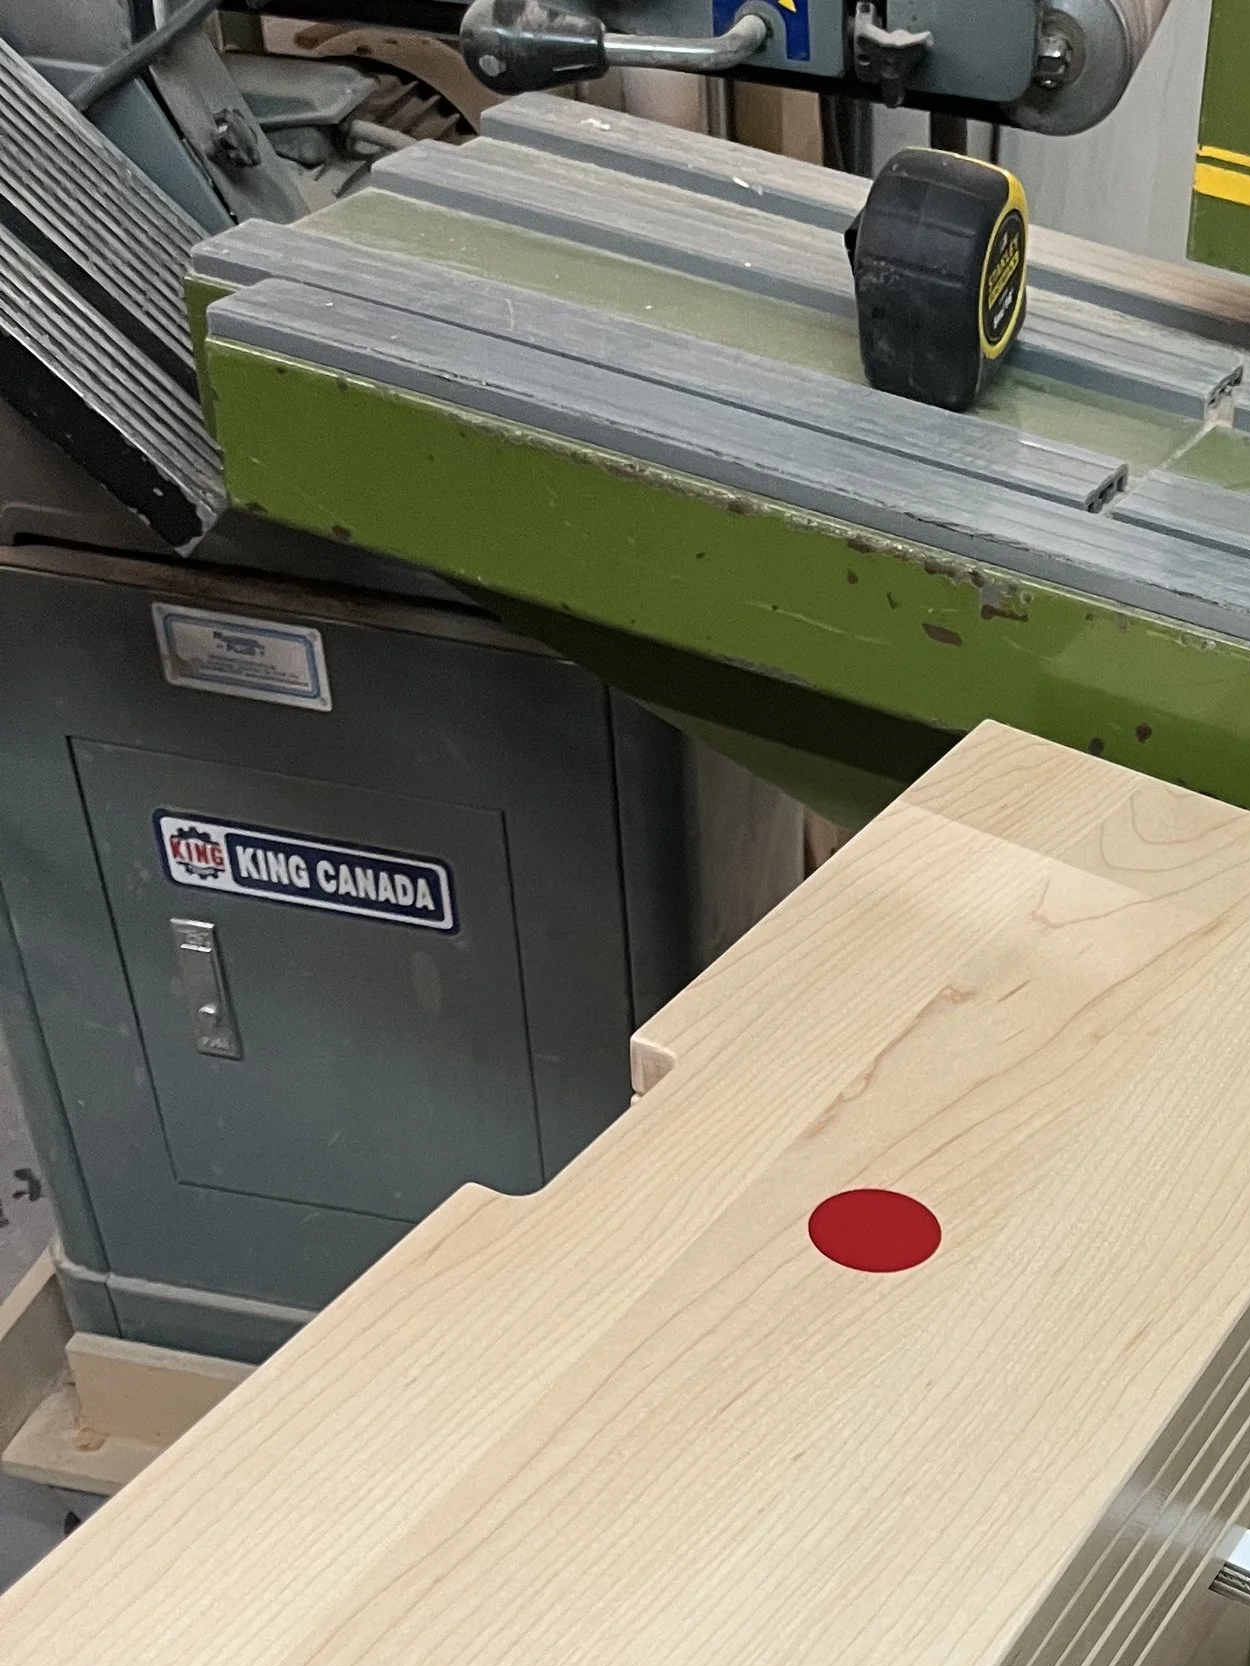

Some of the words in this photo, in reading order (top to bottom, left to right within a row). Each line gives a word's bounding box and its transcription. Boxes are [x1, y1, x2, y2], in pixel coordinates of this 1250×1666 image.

[169, 836, 225, 869] KING
[236, 845, 310, 888] KING
[316, 860, 435, 910] CANADA
